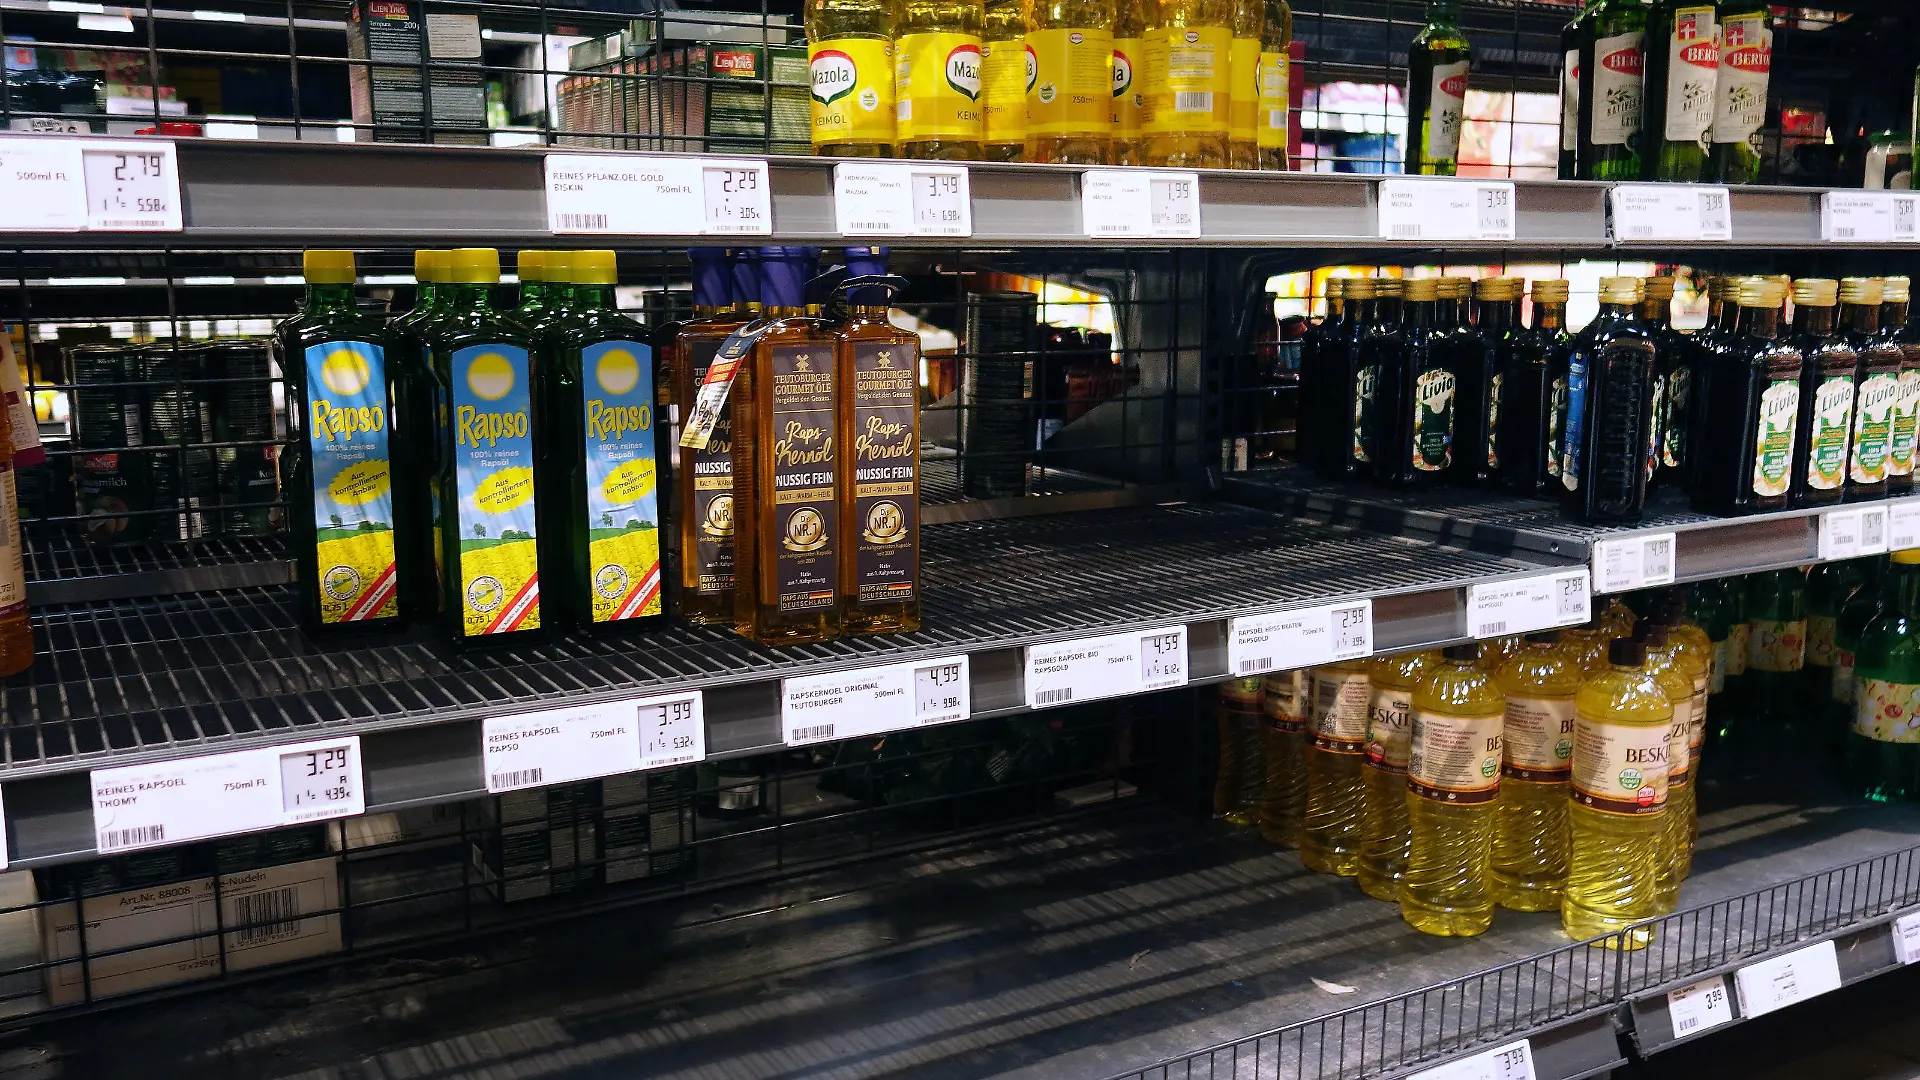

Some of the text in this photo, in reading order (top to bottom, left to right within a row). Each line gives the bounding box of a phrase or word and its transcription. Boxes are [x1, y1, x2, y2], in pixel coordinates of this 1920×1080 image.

[404, 21, 417, 30] 200
[715, 54, 753, 70] LIEN YING
[813, 66, 850, 86] Mazola
[815, 113, 847, 126] KEIMÖL
[116, 155, 160, 180] 2.79
[17, 172, 68, 181] 500ml FL
[553, 173, 664, 182] REINES PFLANZ.OEL GOLD
[723, 171, 756, 193] 2.29
[656, 185, 681, 193] 750ml
[929, 176, 958, 197] 3.49
[1168, 182, 1189, 201] 1.99
[1488, 191, 1507, 208] 3.59
[774, 373, 831, 384] TEUTOBURGER
[856, 370, 912, 380] TEUTOBURGER
[775, 382, 832, 395] GOURMET ÖLE
[857, 379, 913, 391] GOURMET ÖLE
[312, 399, 384, 442] Rapso
[457, 404, 528, 449] Rapso
[587, 399, 651, 441] Rapso
[866, 415, 907, 439] Raps-
[785, 420, 826, 445] Raps-
[326, 443, 376, 452] 100% reines
[470, 449, 520, 459] 100% reines
[599, 442, 644, 451] 100% reines
[775, 436, 834, 467] Kernöl
[856, 432, 914, 461] Kernöl
[621, 469, 634, 479] Aus
[695, 461, 731, 474] NUSSIG
[856, 466, 913, 481] NUSSIG FEIN
[335, 470, 387, 496] kontrolliertem
[351, 471, 365, 481] Aus
[495, 478, 509, 488] Aus
[606, 469, 653, 495] kontrolliertem
[776, 472, 833, 487] NUSSIG FEIN
[353, 483, 376, 497] Anbau
[479, 478, 531, 504] kontrolliertem
[622, 483, 644, 496] Anbau
[496, 491, 520, 505] Anbau
[880, 508, 889, 516] Die
[861, 589, 911, 600] DEUTSCHLAND
[1565, 579, 1583, 596] 2.99
[782, 598, 832, 609] DEUTSCHLAND
[1342, 609, 1364, 628] 2.99
[1153, 635, 1178, 655] 4.59
[1238, 636, 1269, 645] RAPSGOLD
[1034, 656, 1057, 666] REINES
[930, 665, 959, 688] 4.99
[1034, 664, 1069, 675] RAPSGOLD
[790, 682, 879, 701] RAPSKERNOEL ORIGINAL
[790, 697, 843, 710] TEUTOBURGER
[874, 689, 896, 699] 500ml
[658, 702, 691, 727] 3.99
[488, 727, 561, 743] REINES RAPSOEL
[489, 727, 626, 754] RAPSO 750ml FL
[307, 749, 346, 776] 3.29
[97, 778, 187, 797] REINES RAPSOEL
[98, 778, 267, 808] THOMY 750ml FL
[159, 886, 191, 900] 88008
[205, 872, 267, 891] Me-Nudeln
